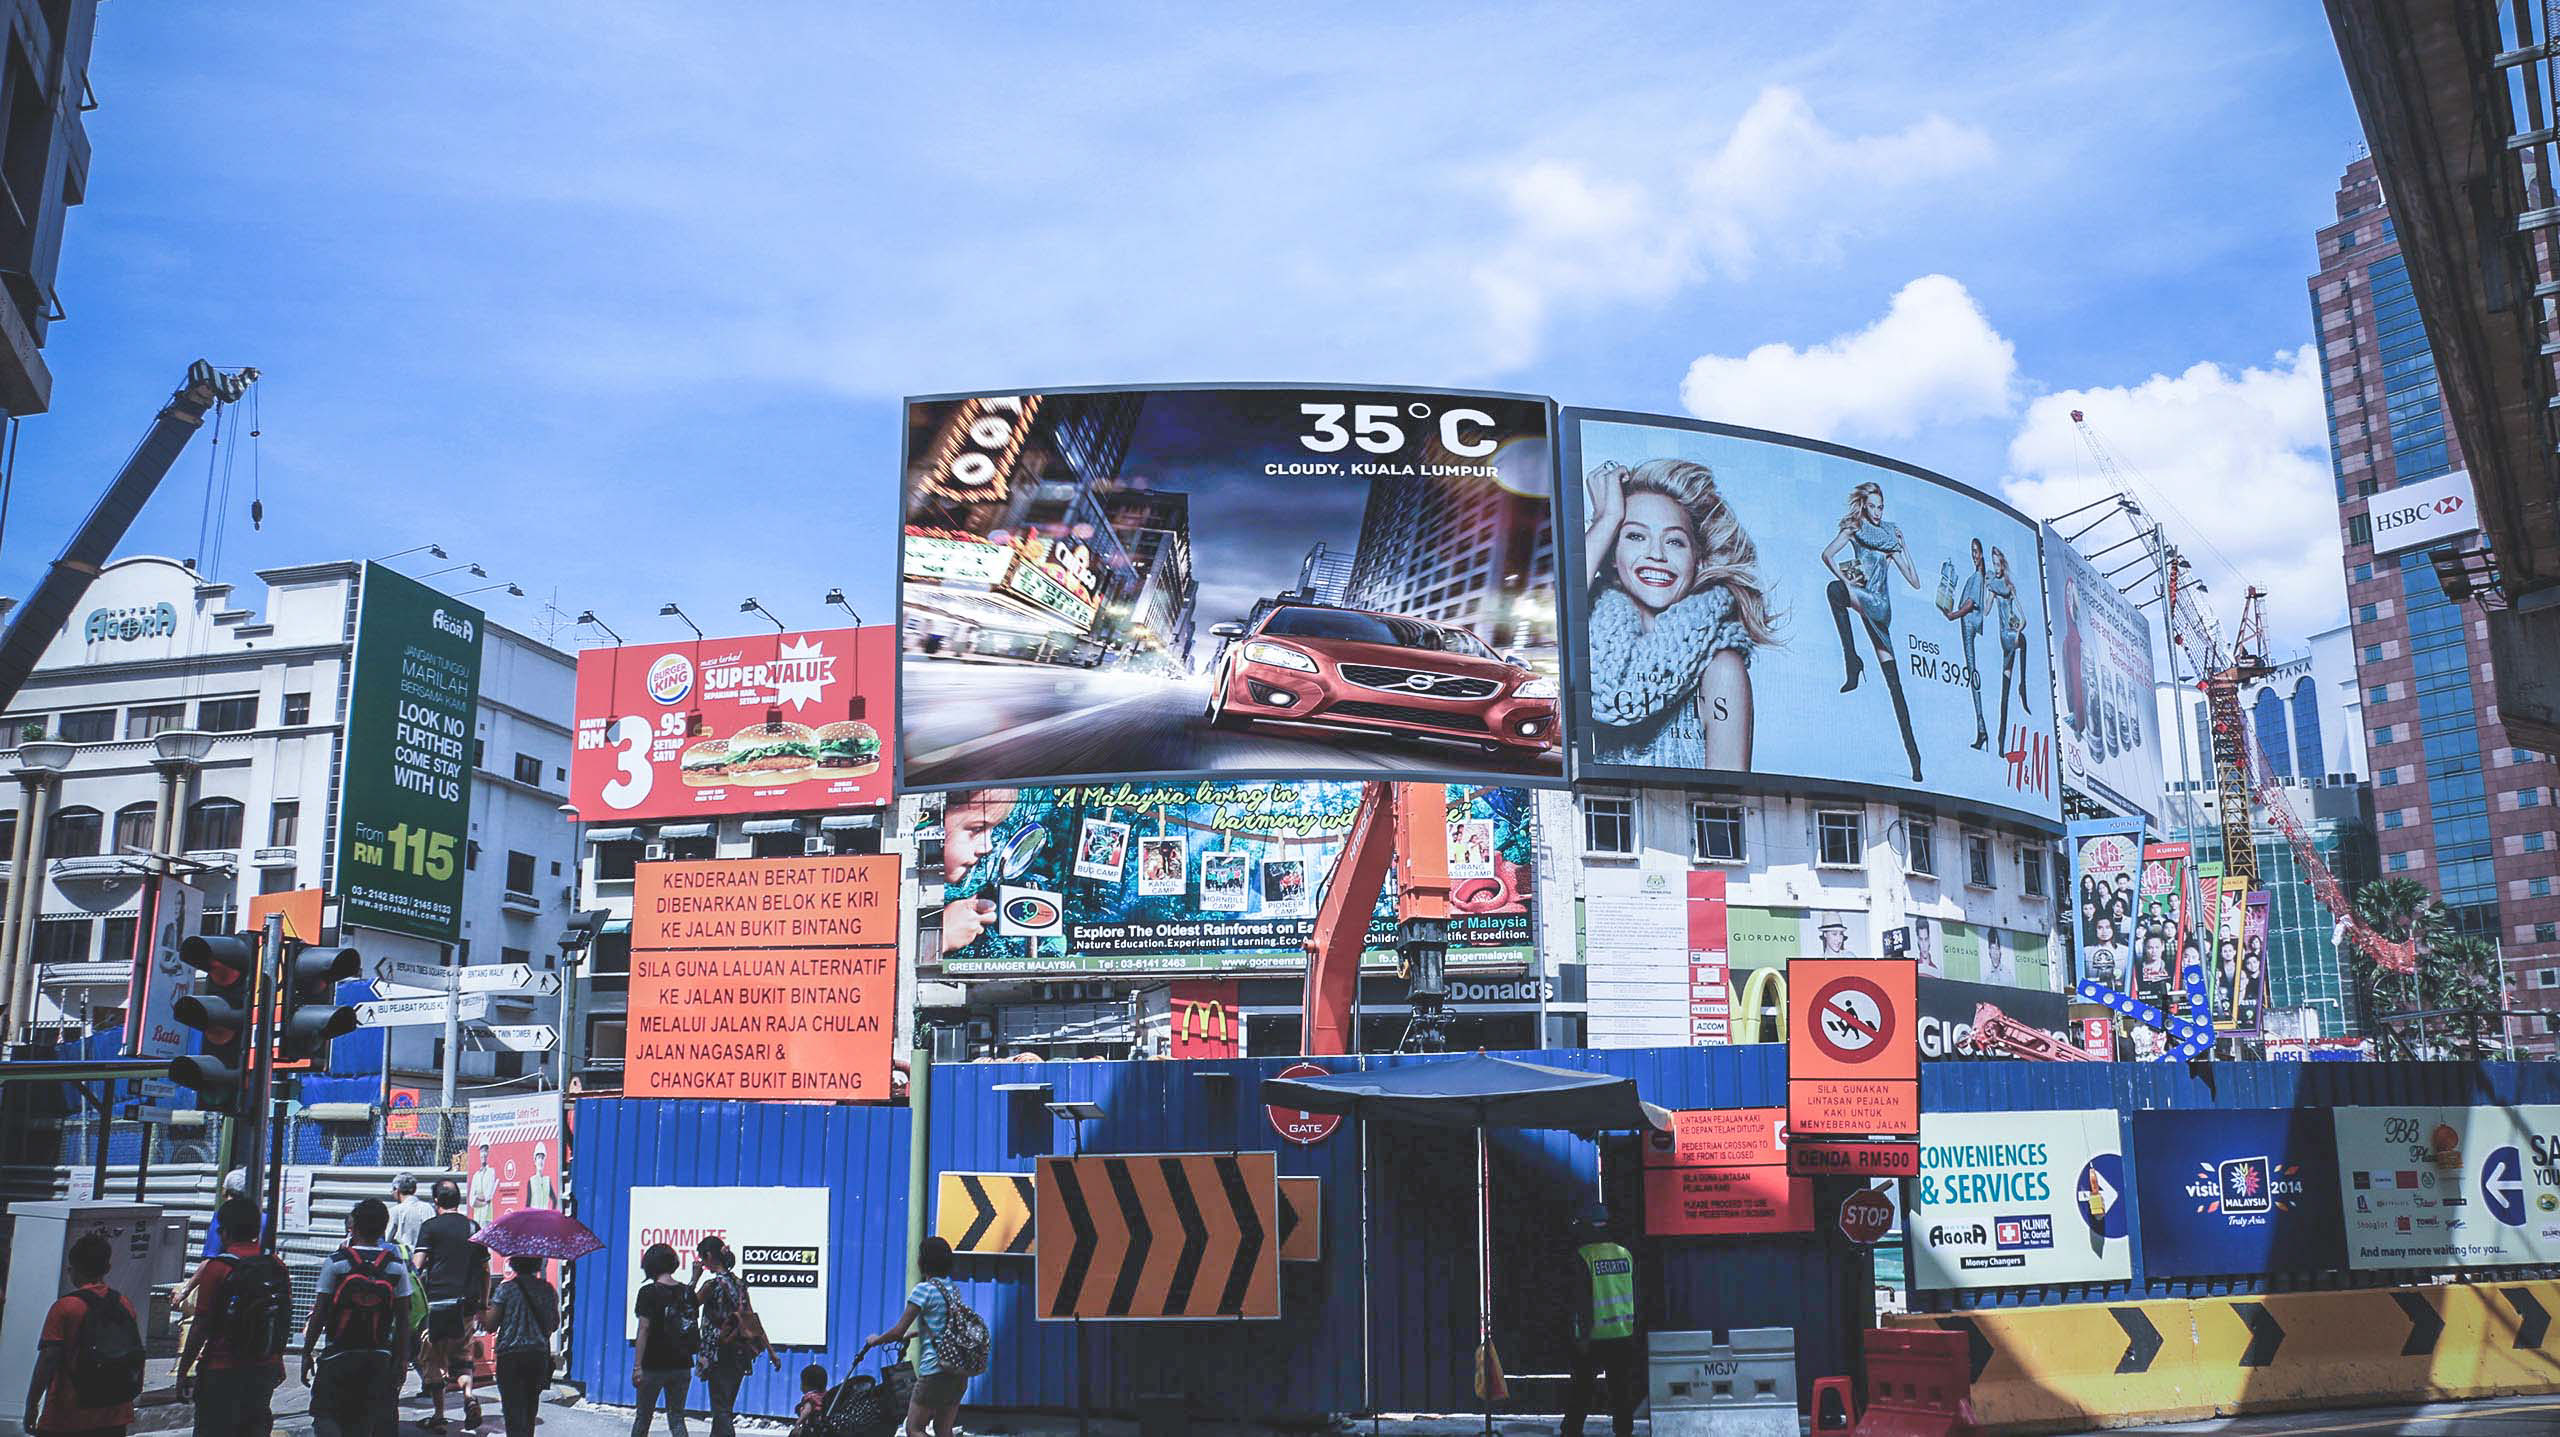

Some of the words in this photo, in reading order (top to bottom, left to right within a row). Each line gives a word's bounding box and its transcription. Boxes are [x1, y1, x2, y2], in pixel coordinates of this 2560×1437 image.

[1265, 463, 1345, 477] CLOUDY,
[1352, 463, 1415, 476] KUALA
[1420, 465, 1498, 478] LUMPUR
[2376, 503, 2431, 532] HSBC
[1908, 634, 1940, 656] Dress
[402, 659, 469, 697] MARILAH
[653, 662, 687, 682] BURGER
[704, 664, 768, 691] SUPER
[776, 659, 831, 684] VALUE
[1910, 654, 1937, 680] RM
[1941, 661, 1981, 691] 39.90
[655, 671, 688, 694] KING
[400, 700, 441, 728] LOOK
[444, 715, 465, 739] NO
[397, 723, 462, 760] FURTHER
[578, 730, 606, 750] RM
[653, 738, 684, 749] SETIAP
[395, 746, 430, 771] COME
[433, 756, 462, 779] STAY
[601, 715, 654, 810] 3
[654, 712, 687, 737] .95
[653, 750, 677, 762] SATU
[2005, 723, 2050, 802] H&M
[394, 766, 434, 795] WITH
[438, 777, 460, 803] US
[1080, 782, 1190, 814] Malaysia
[1195, 780, 1267, 811] living
[1271, 784, 1299, 802] in
[1211, 806, 1318, 836] harmony
[355, 822, 384, 844] From
[353, 842, 383, 866] RM
[663, 870, 759, 889] KENDERAAN
[764, 868, 816, 886] BERAT
[821, 866, 869, 884] TIDAK
[1077, 865, 1095, 876] BUG
[1096, 868, 1119, 878] CAMP
[351, 885, 363, 897] 03
[656, 895, 757, 914] DIBENARKAN
[762, 893, 816, 911] BELOK
[821, 892, 842, 909] KE
[847, 891, 879, 908] KIRI
[661, 922, 681, 938] KE
[685, 921, 735, 937] JALAN
[740, 919, 787, 936] BUKIT
[792, 918, 862, 935] BINTANG
[1074, 925, 1125, 941] Explore
[1128, 923, 1154, 938] The
[1156, 921, 1201, 937] Oldest
[1203, 919, 1274, 936] Rainforest
[1277, 920, 1294, 934] on
[1467, 916, 1528, 932] Malaysia
[1470, 929, 1530, 942] Expedition.
[1733, 932, 1796, 942] GIORDANO
[638, 961, 671, 977] SILA
[675, 960, 719, 977] GUNA
[723, 960, 786, 976] LALUAN
[790, 958, 887, 976] ALTERNATIF
[948, 962, 982, 972] GREEN
[983, 961, 1026, 971] RANGER
[1026, 959, 1077, 970] MALAYSIA
[1098, 959, 1113, 969] Tel
[1120, 958, 1160, 968] 03-6141
[660, 988, 679, 1004] KE
[684, 988, 734, 1004] JALAN
[739, 987, 786, 1004] BUKIT
[791, 987, 861, 1004] BINTANG
[389, 1002, 418, 1013] PEJABAT
[418, 1001, 436, 1011] POLIS
[640, 1016, 706, 1032] MELALUI
[710, 1016, 761, 1032] JALAN
[766, 1016, 807, 1032] RAJA
[812, 1015, 879, 1032] CHULAN
[152, 1025, 180, 1045] Bata
[636, 1044, 685, 1060] JALAN
[690, 1044, 771, 1060] NAGASARI
[775, 1043, 786, 1060] &
[650, 1071, 735, 1088] CHANGKAT
[740, 1071, 787, 1088] BUKIT
[791, 1071, 862, 1089] BINTANG
[1818, 1085, 1837, 1094] SILA
[1843, 1086, 1889, 1094] GUNAKAN
[1808, 1097, 1851, 1105] LINTASAN
[1856, 1097, 1899, 1105] PEJALAN
[1681, 1116, 1711, 1124] LINTASAN
[1824, 1109, 1846, 1117] KAKI
[1851, 1109, 1882, 1117] UNTUK
[1289, 1124, 1322, 1133] GATE
[1681, 1126, 1691, 1134] KE
[1800, 1120, 1870, 1129] MENYEBERANG
[1876, 1121, 1907, 1129] JALAN
[2385, 1118, 2419, 1144] BB
[1682, 1143, 1722, 1151] PEDESTRIAN
[1724, 1141, 1758, 1149] CROSSING
[1696, 1152, 1719, 1160] FRONT
[1728, 1151, 1754, 1159] CLOSED
[1798, 1152, 1850, 1166] DENDA
[1860, 1152, 1909, 1168] RM500
[1920, 1143, 2048, 1168] CONVENIENCES
[1921, 1175, 1939, 1205] &
[1944, 1172, 2050, 1203] SERVICES
[2185, 1181, 2219, 1197] visit
[2271, 1181, 2303, 1194] 2014
[2225, 1198, 2267, 1208] MALAYSIA
[1846, 1206, 1889, 1226] STOP
[2021, 1219, 2049, 1230] KLINIK
[2228, 1216, 2247, 1227] Truly
[2248, 1216, 2266, 1225] Asia
[2360, 1247, 2380, 1258] And
[2381, 1247, 2406, 1258] many
[2408, 1247, 2432, 1256] more
[2434, 1245, 2467, 1257] waiting
[2468, 1244, 2481, 1254] for
[1965, 1258, 1988, 1268] Money
[1989, 1256, 2021, 1267] Changers
[746, 1273, 815, 1283] GIORDANO
[1704, 1362, 1738, 1375] MGJV
